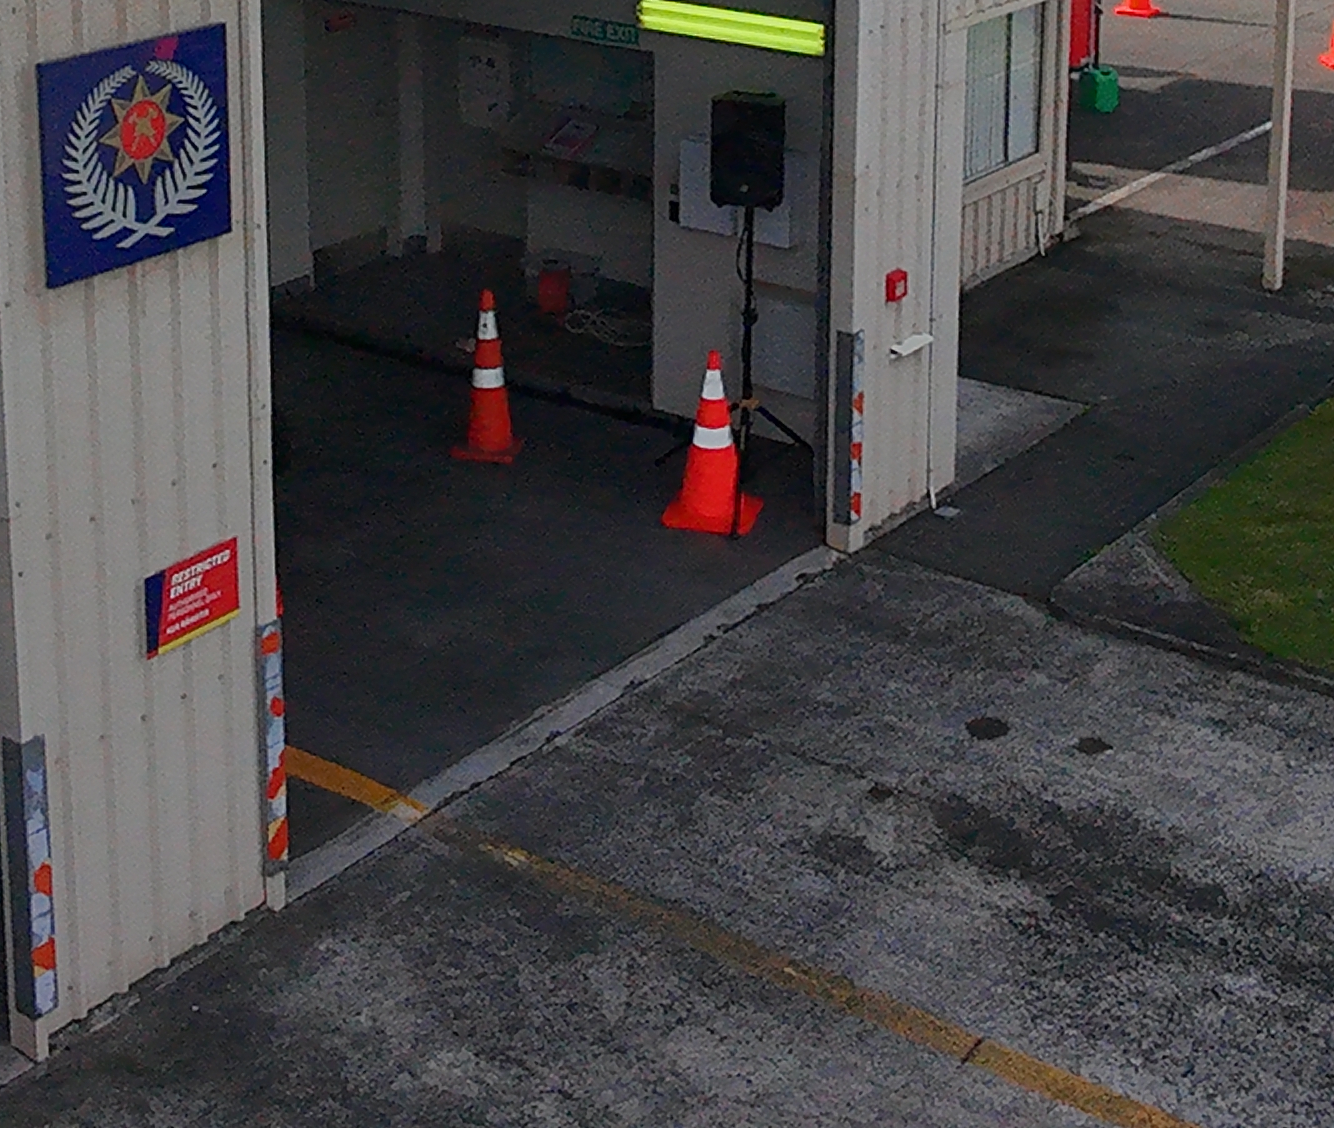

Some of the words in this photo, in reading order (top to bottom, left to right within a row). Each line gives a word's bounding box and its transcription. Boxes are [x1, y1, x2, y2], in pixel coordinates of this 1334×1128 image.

[571, 18, 604, 39] FIRE
[606, 24, 636, 43] EXIT
[171, 549, 231, 587] RESTRICTED
[170, 574, 204, 599] ENTRY
